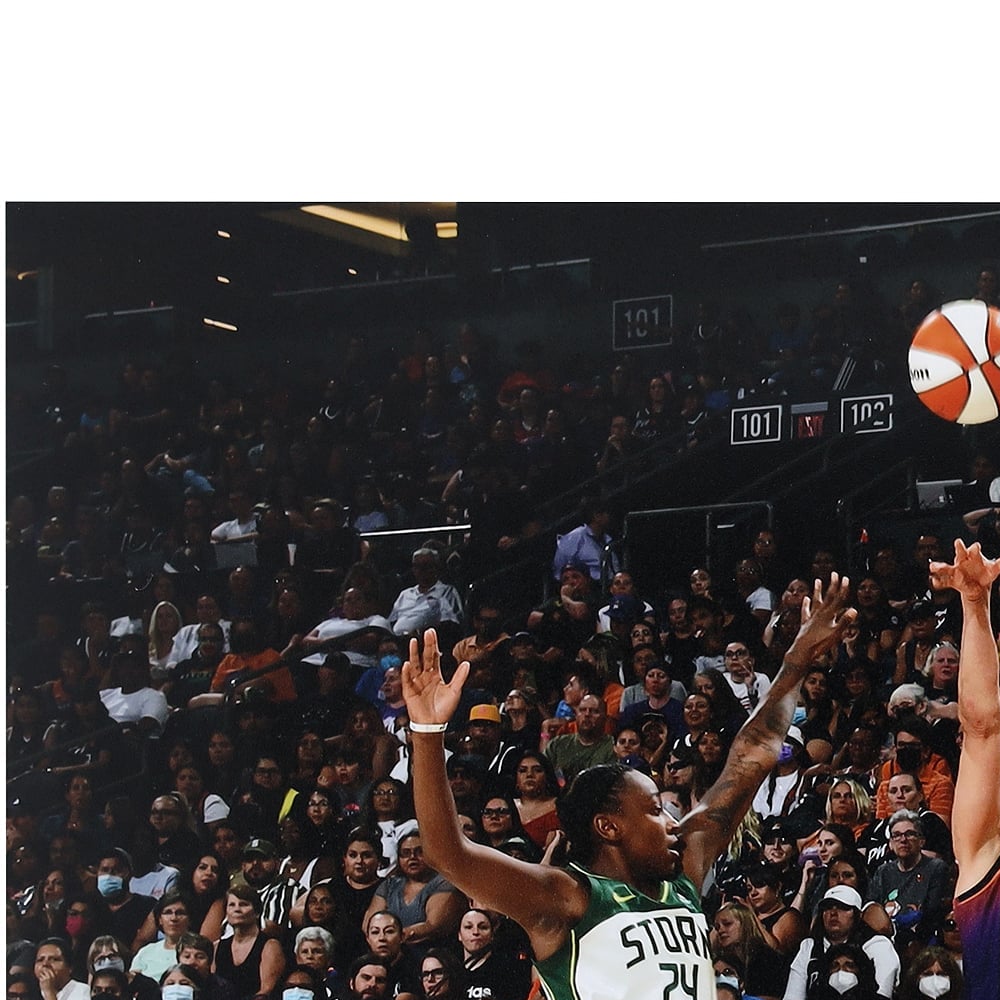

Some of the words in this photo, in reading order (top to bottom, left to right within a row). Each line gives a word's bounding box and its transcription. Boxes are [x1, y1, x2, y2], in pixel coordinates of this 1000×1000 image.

[624, 306, 659, 338] 101
[741, 411, 771, 438] 101
[851, 401, 885, 426] 102
